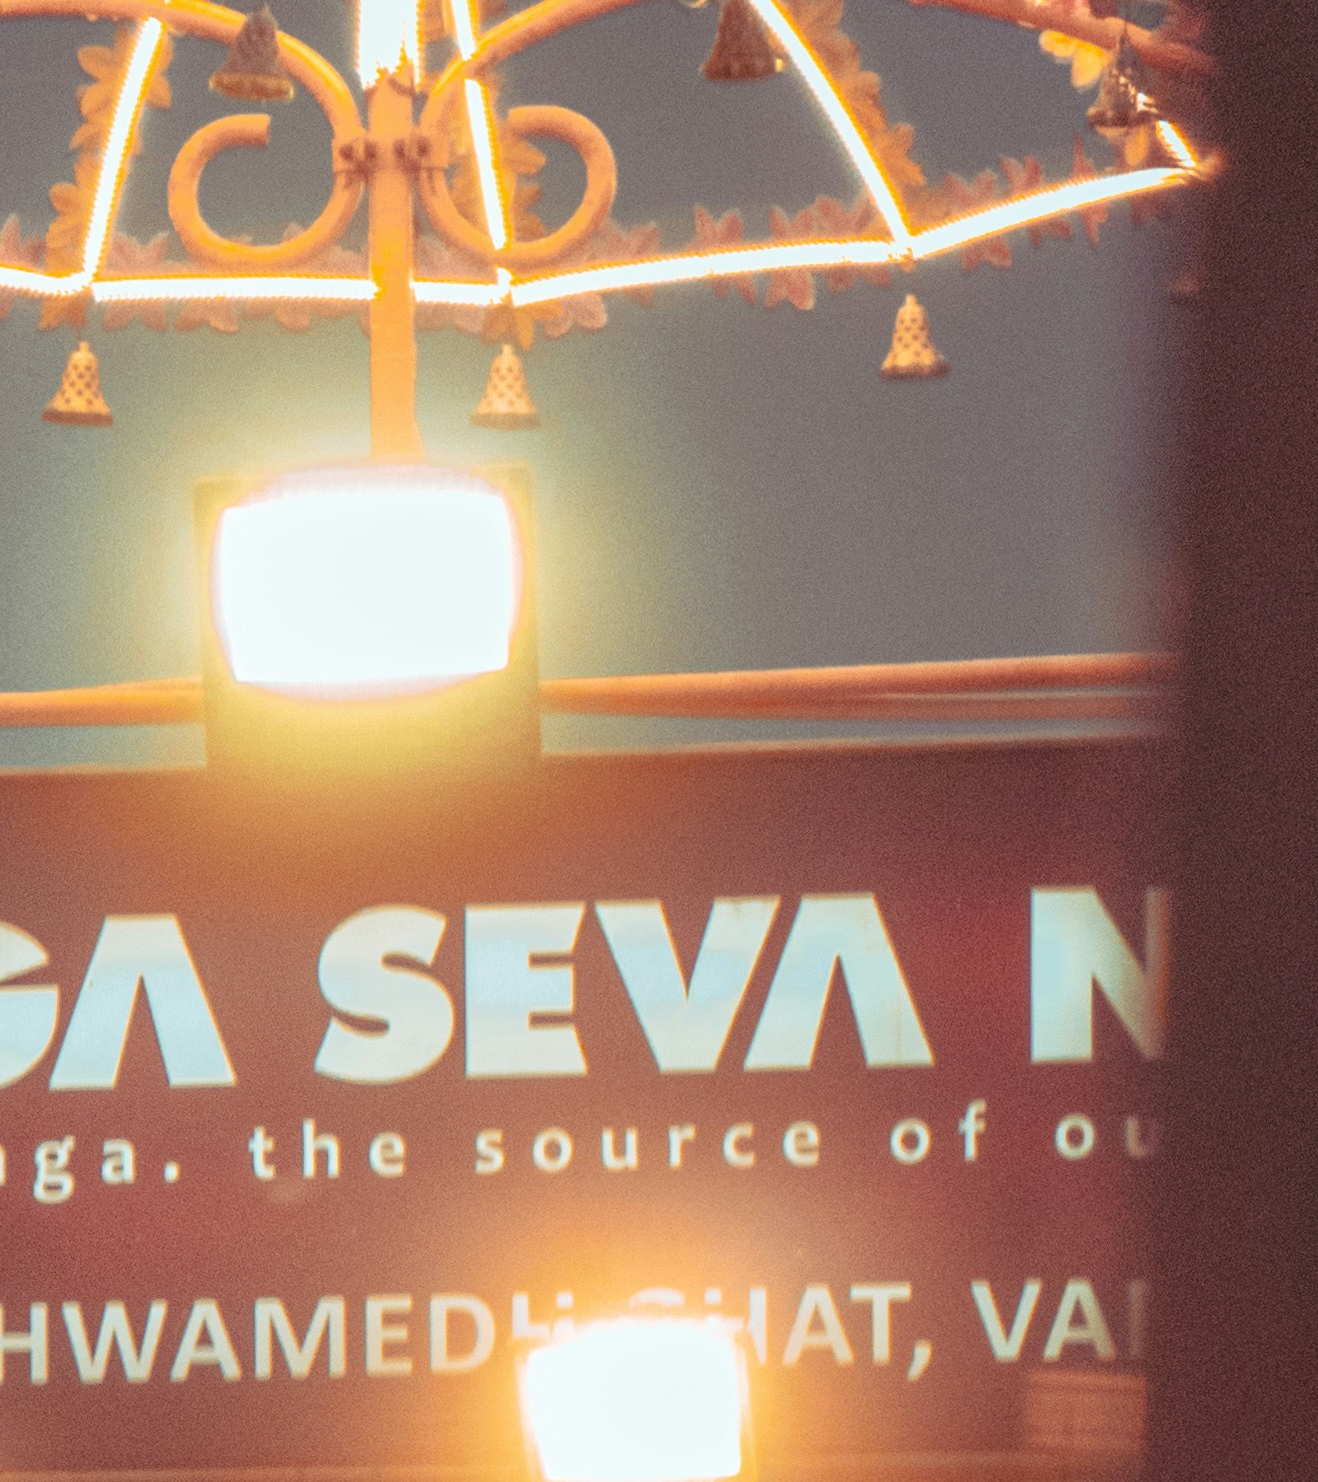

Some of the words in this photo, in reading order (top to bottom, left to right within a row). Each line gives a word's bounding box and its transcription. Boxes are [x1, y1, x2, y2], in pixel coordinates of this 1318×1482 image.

[312, 890, 935, 1086] SEVA
[248, 1118, 407, 1181] the
[473, 1118, 822, 1175] source
[888, 1098, 988, 1165] of
